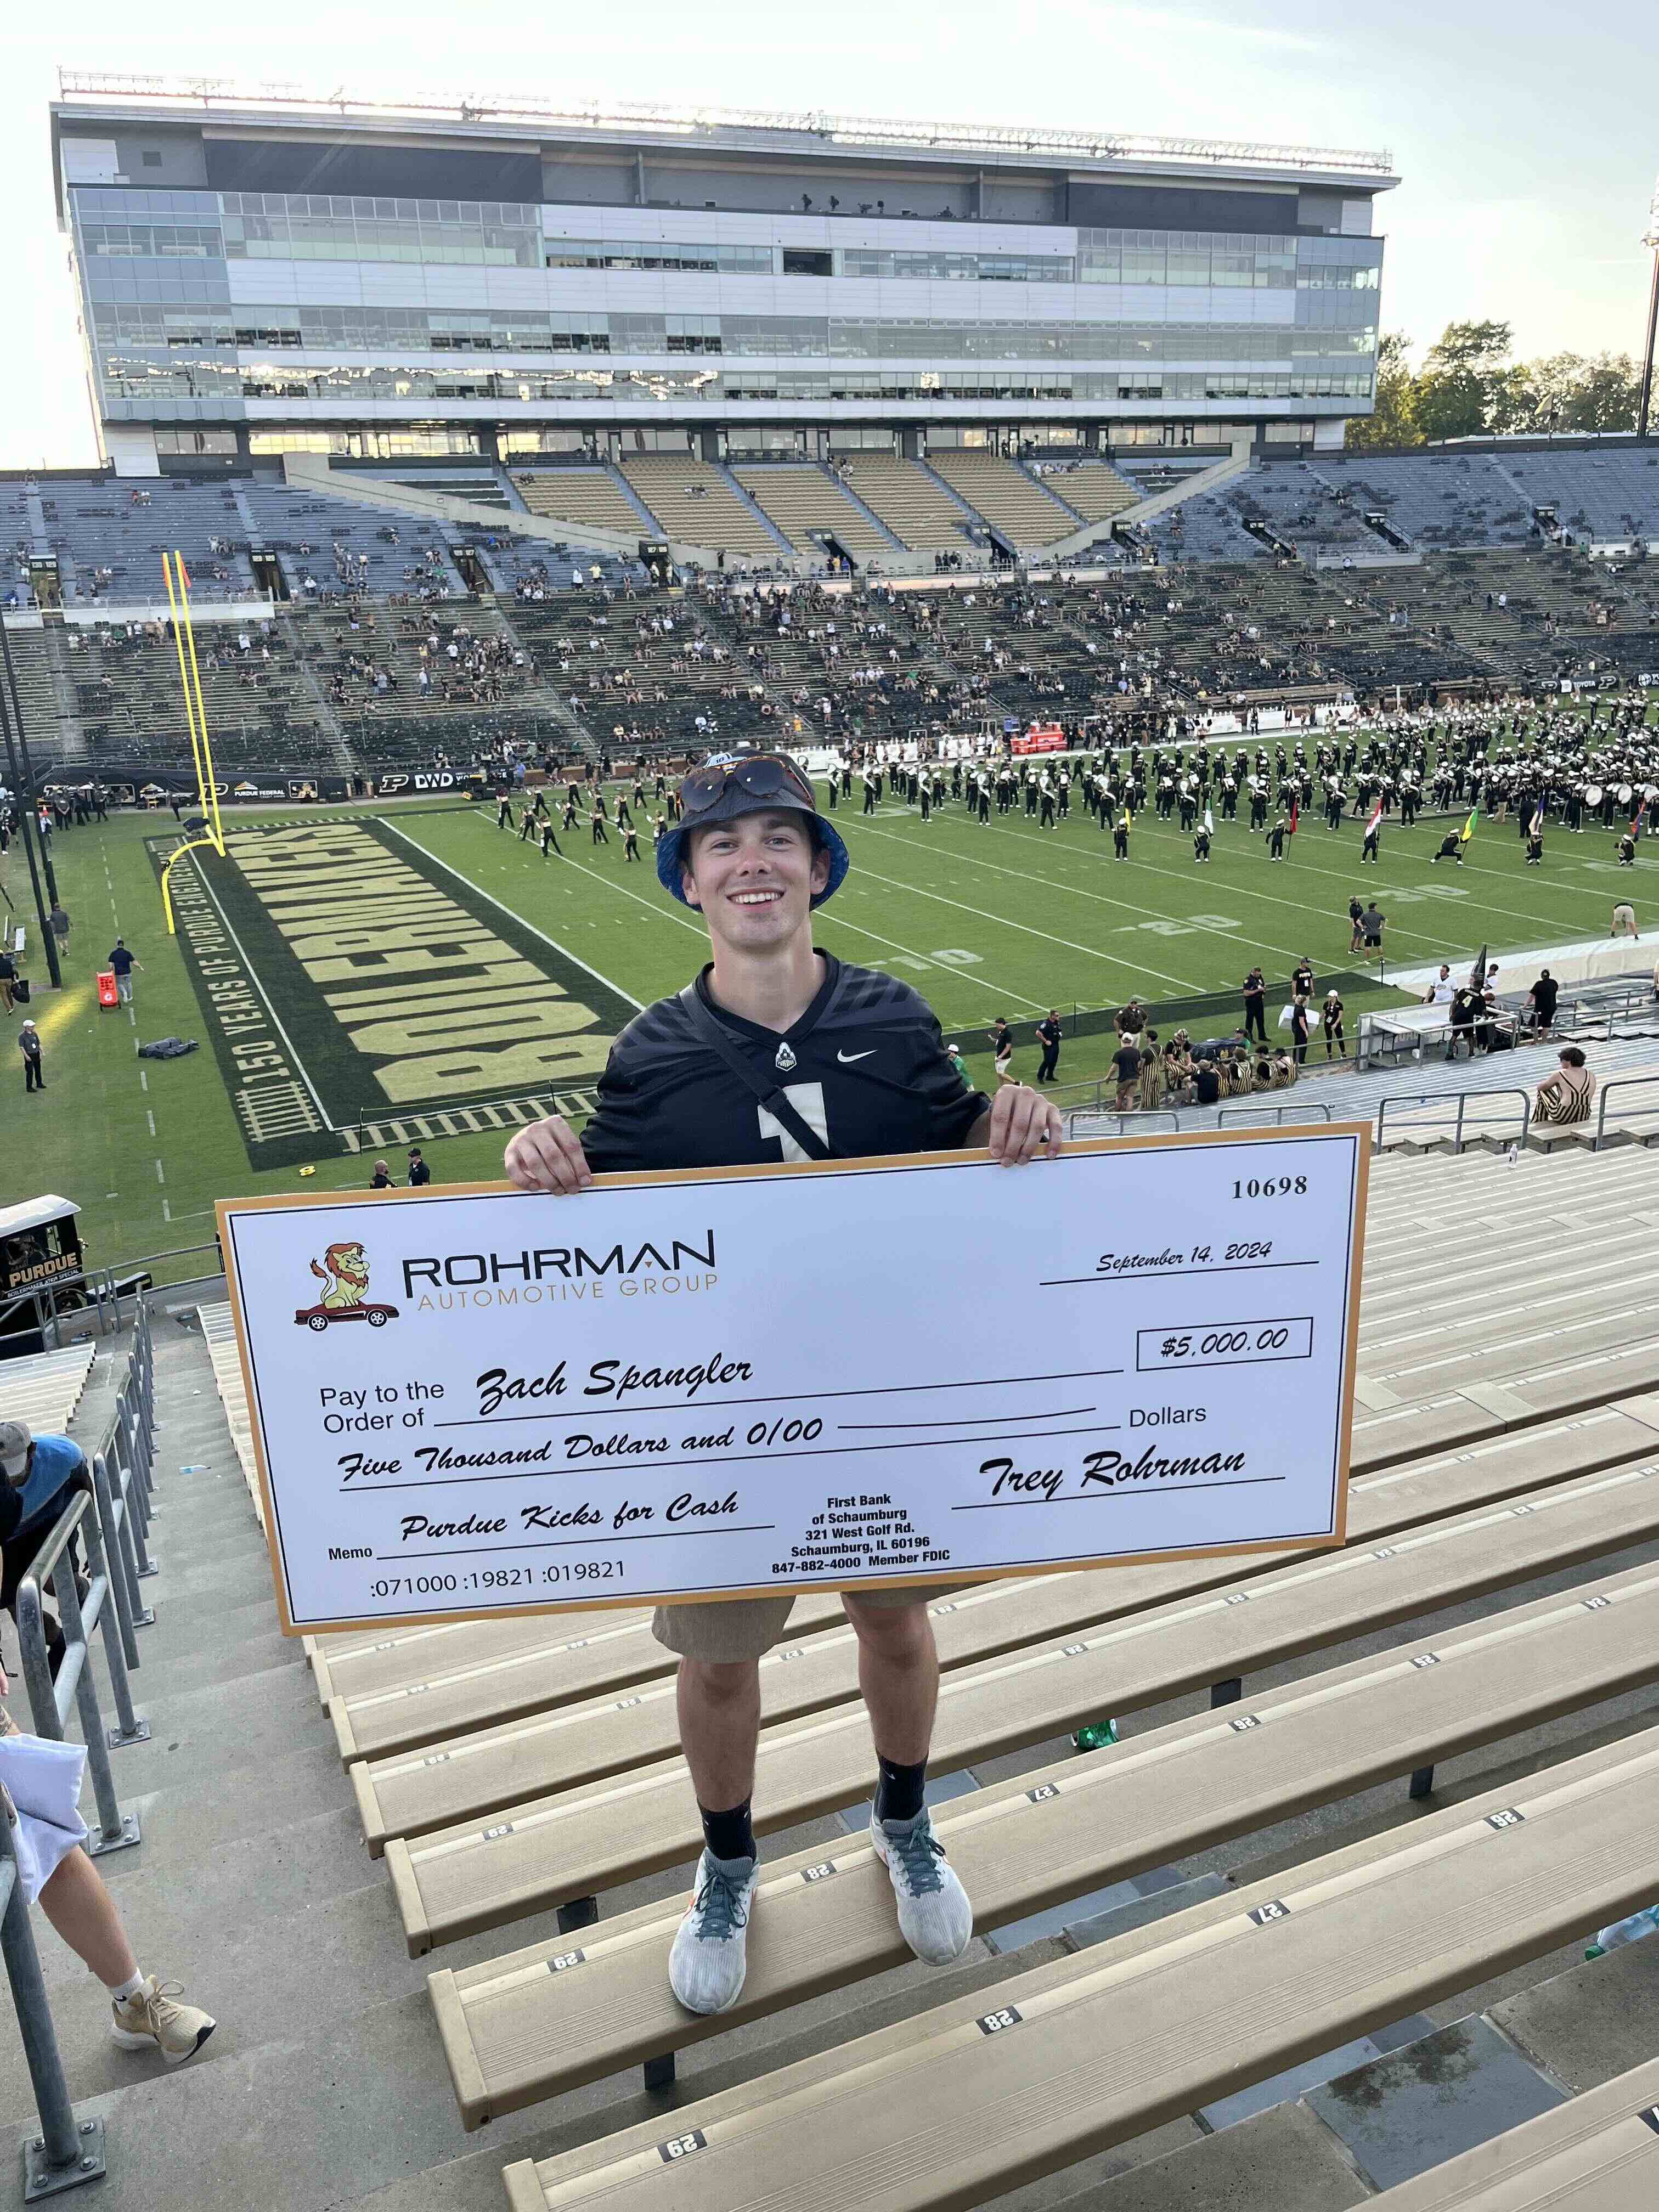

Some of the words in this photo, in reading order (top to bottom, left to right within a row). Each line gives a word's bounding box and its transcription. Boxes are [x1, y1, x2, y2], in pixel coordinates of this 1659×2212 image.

[1573, 680, 1595, 689] TOYOTA
[414, 772, 454, 789] DWD
[180, 908, 231, 954] PURDUE
[1137, 915, 1243, 935] 20
[198, 958, 240, 976] OF
[222, 825, 619, 1103] BOILERMAKERS
[888, 949, 984, 970] 10
[207, 980, 268, 1036] YEARS
[232, 1040, 290, 1084] 150
[758, 1082, 830, 1163] 1
[1232, 1176, 1308, 1199] 10698
[402, 1229, 715, 1299] ROHRMAN
[1096, 1248, 1184, 1273] September
[1225, 1242, 1273, 1260] 2024
[9, 1251, 78, 1288] PURDUE
[59, 1268, 79, 1280] SPECIAL
[417, 1282, 603, 1311] AUTOMOTIVE
[619, 1274, 718, 1296] GROUP
[1160, 1328, 1288, 1358] $5,000.00
[477, 1361, 567, 1415] Zach
[584, 1352, 753, 1400] Spangler
[320, 1387, 367, 1410] Pay
[375, 1385, 398, 1403] to
[407, 1381, 444, 1400] the
[324, 1410, 395, 1434] Order
[402, 1407, 425, 1429] of
[1130, 1406, 1207, 1428] Dollars
[337, 1454, 402, 1482] Five
[414, 1440, 552, 1472] Thousand
[564, 1432, 671, 1462] Dollars
[681, 1426, 735, 1450] and
[746, 1417, 823, 1448] 0/00
[979, 1457, 1064, 1500] Trey
[1080, 1444, 1245, 1489] Rohrman
[827, 1497, 856, 1509] First
[860, 1493, 891, 1506] Bank
[400, 1514, 507, 1543] Purdue
[521, 1504, 604, 1530] Kicks
[613, 1499, 656, 1525] for
[665, 1491, 740, 1519] Cash
[812, 1513, 824, 1525] of
[828, 1509, 907, 1524] Schaumburg
[805, 1529, 827, 1541] 321
[832, 1526, 863, 1539] West
[866, 1523, 891, 1536] Golf
[895, 1523, 915, 1534] Rd.
[328, 1545, 373, 1561] Memo
[791, 1542, 873, 1558] Schaumburg,
[877, 1541, 888, 1551] IL
[891, 1537, 930, 1549] 60196
[771, 1557, 861, 1573] 847-882-4000
[868, 1554, 919, 1566] Member
[922, 1550, 950, 1562] FDIC
[370, 1574, 458, 1598] :071000
[463, 1567, 534, 1591] :19821
[541, 1561, 625, 1584] :019821
[1585, 1598, 1606, 1609] 24
[1413, 1655, 1435, 1667] 25
[1233, 1717, 1255, 1729] 26
[1034, 1786, 1054, 1801] 27
[1489, 1810, 1517, 1827] 26
[488, 1824, 507, 1837] 29
[807, 1864, 830, 1879] 28
[1257, 1903, 1283, 1923] 27
[554, 1951, 578, 1970] 29
[984, 2010, 1014, 2032] 28
[667, 2133, 698, 2158] 29
